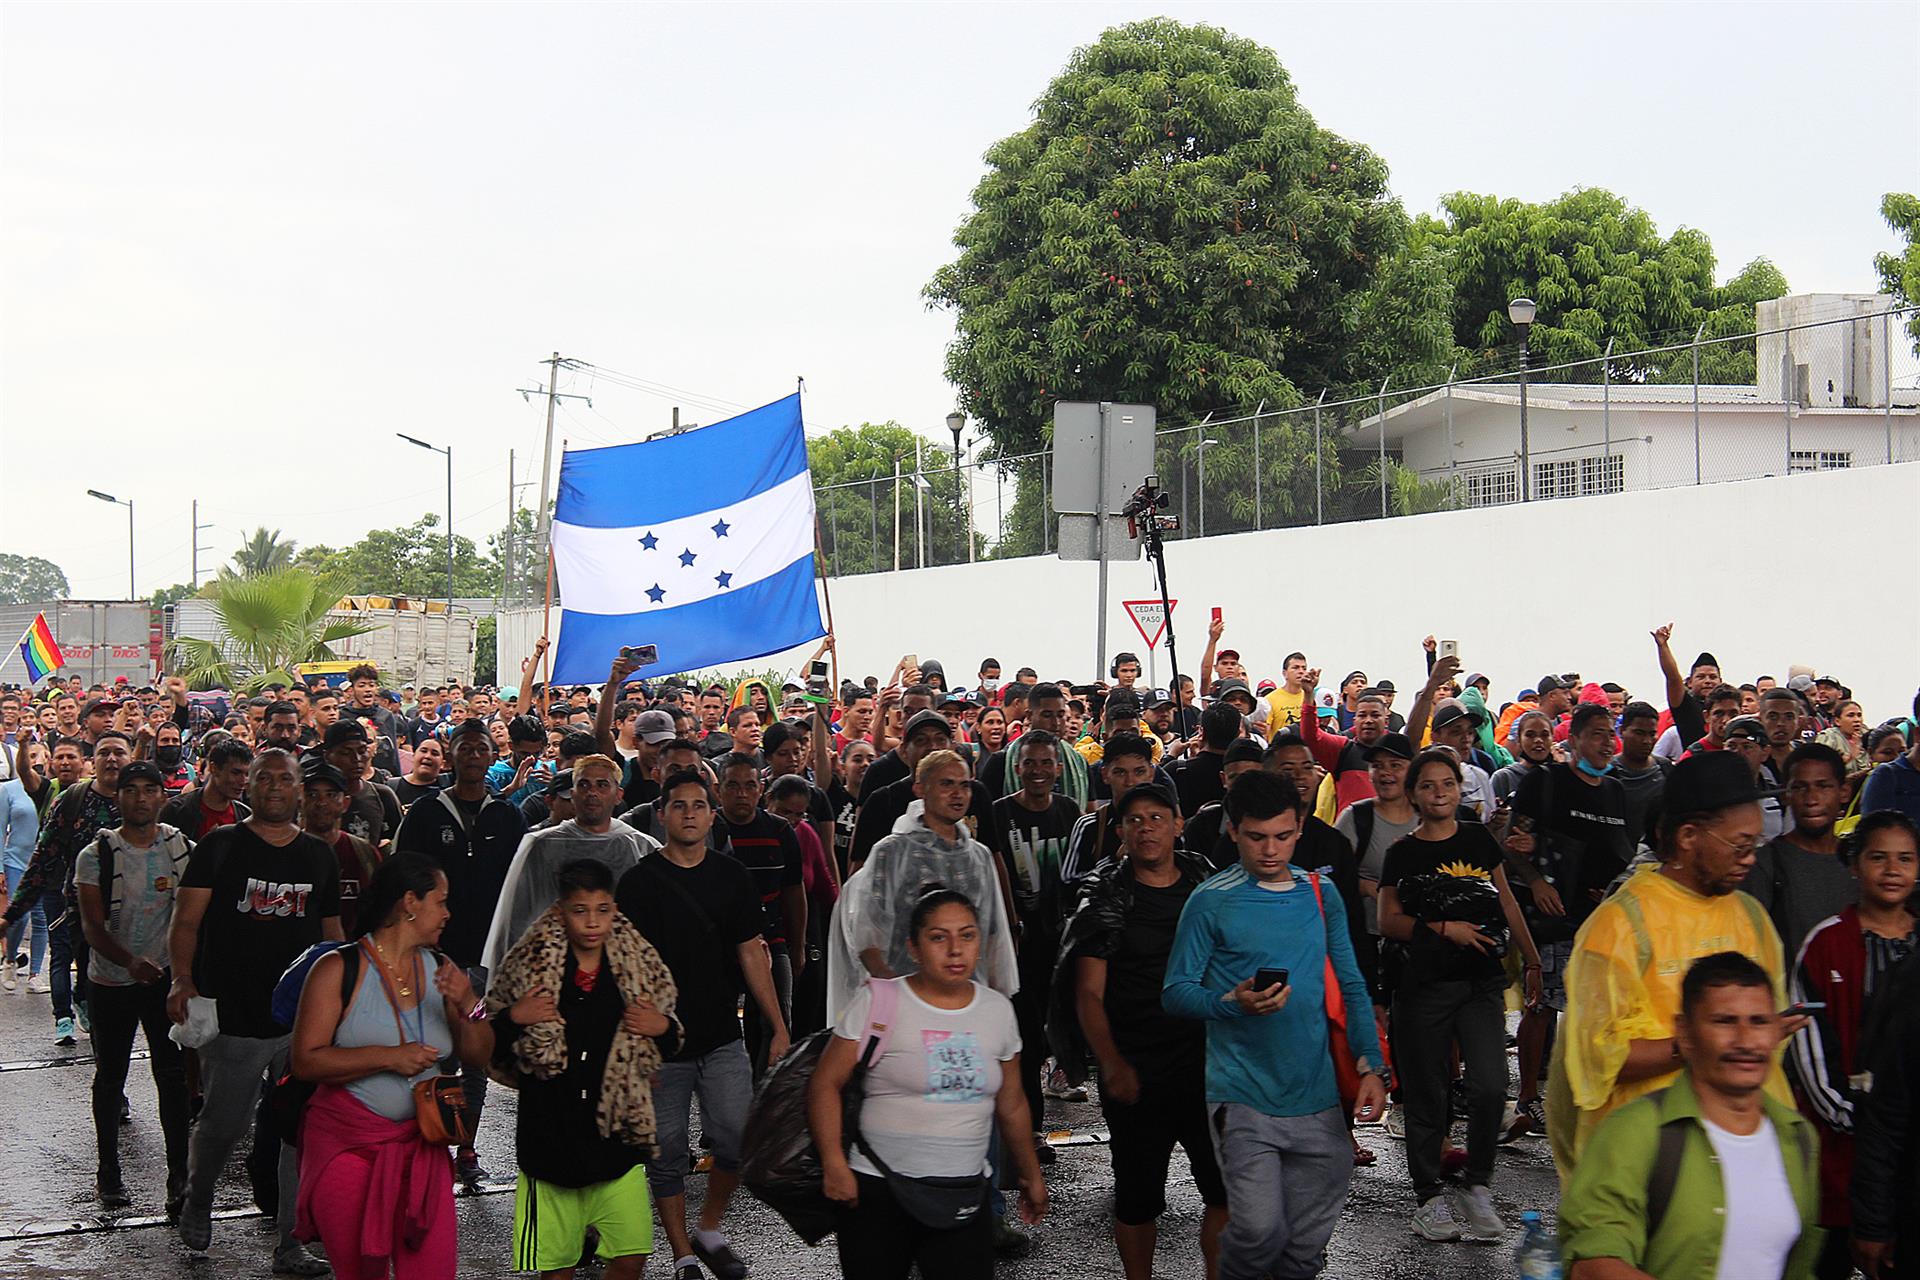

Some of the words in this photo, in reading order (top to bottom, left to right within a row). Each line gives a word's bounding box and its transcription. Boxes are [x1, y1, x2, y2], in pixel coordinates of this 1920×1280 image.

[1135, 605, 1155, 613] CEDA
[62, 649, 92, 658] SOLO
[113, 649, 141, 658] DIOS
[237, 878, 313, 917] JUST
[941, 1073, 976, 1089] DAY
